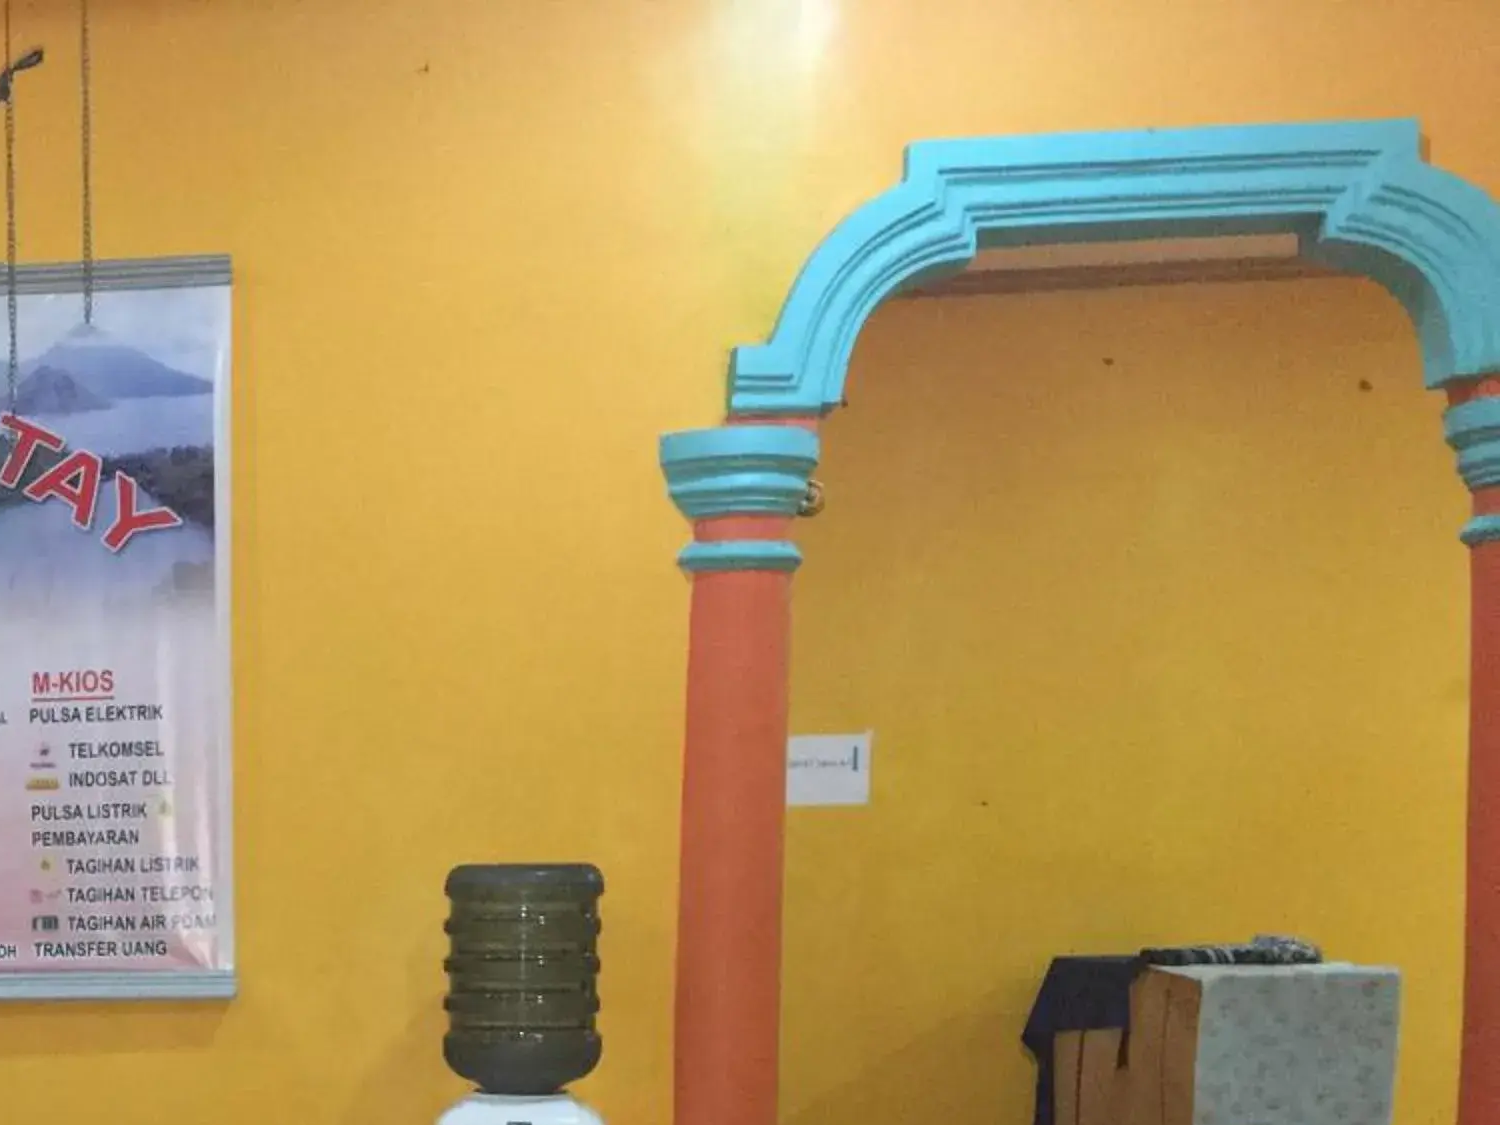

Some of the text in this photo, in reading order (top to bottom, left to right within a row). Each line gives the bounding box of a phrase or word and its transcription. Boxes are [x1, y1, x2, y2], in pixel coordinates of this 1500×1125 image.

[32, 669, 115, 694] M-KIOS
[29, 705, 164, 724] PULSA ELEKTRIK
[68, 741, 165, 759] TELKOMSEL
[69, 771, 137, 787] INDOSAT
[31, 803, 148, 821] PULSA LISTRIK
[32, 830, 140, 847] PEMBAYARAN
[66, 856, 199, 874] TAGIHAN LISTRIK
[66, 886, 135, 903] TAGIHAN
[67, 915, 136, 931] TAGIHAN
[140, 914, 166, 930] AIR
[34, 940, 167, 957] TRANSFER UANG
